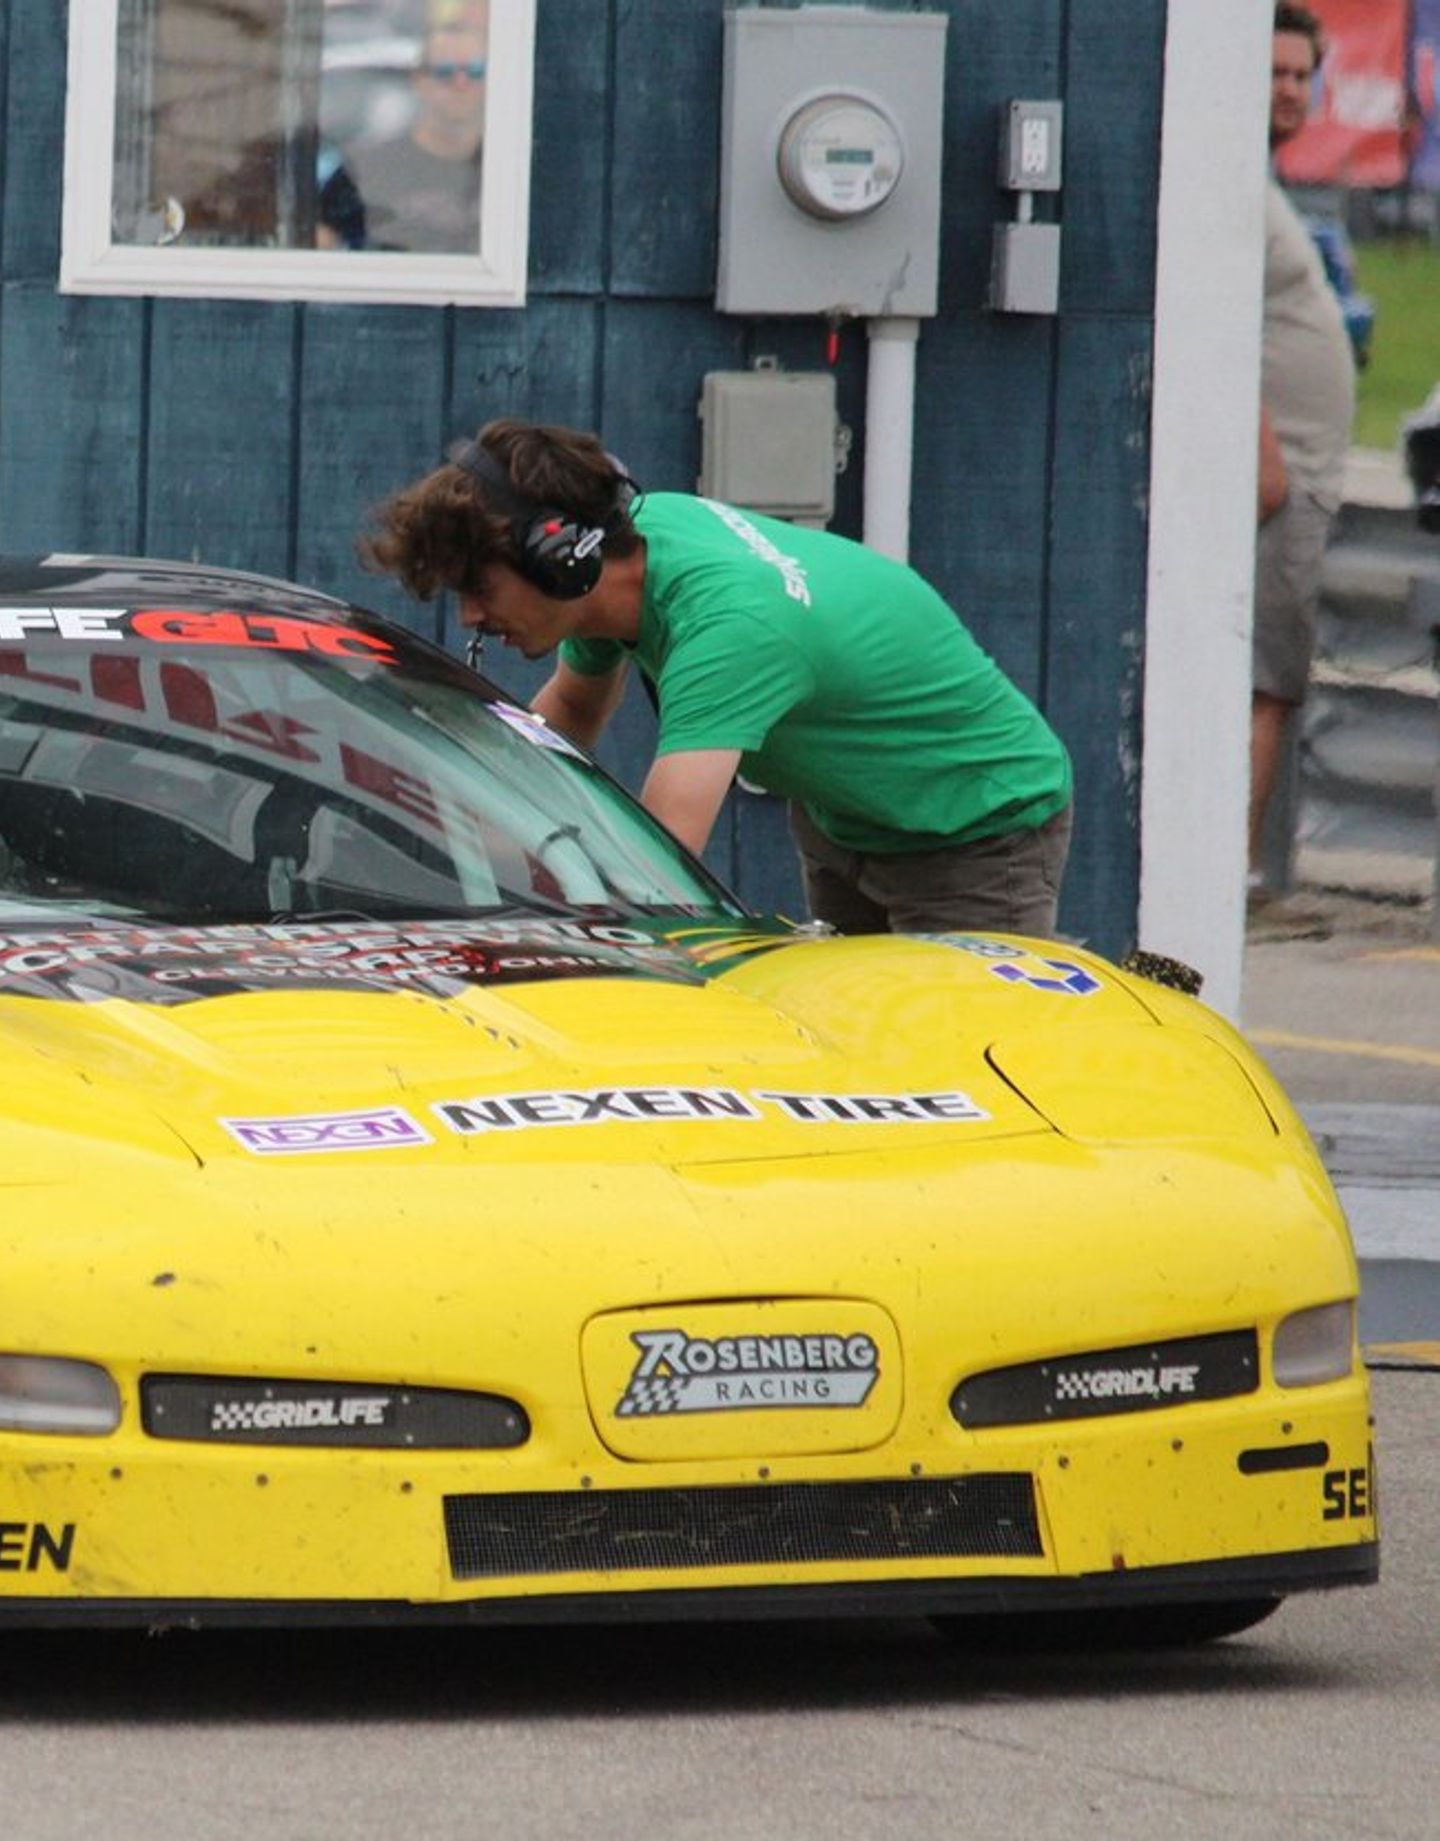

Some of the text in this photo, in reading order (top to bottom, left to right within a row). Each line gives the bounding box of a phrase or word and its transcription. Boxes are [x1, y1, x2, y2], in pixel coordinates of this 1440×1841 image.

[441, 1090, 983, 1132] NEXEN TIRE
[237, 1116, 417, 1147] NEXEN
[630, 1329, 879, 1377] ROSENBERG
[715, 1378, 832, 1400] RACING
[1089, 1365, 1200, 1398] GRIDLIFE
[252, 1397, 390, 1430] GRIDLIFE
